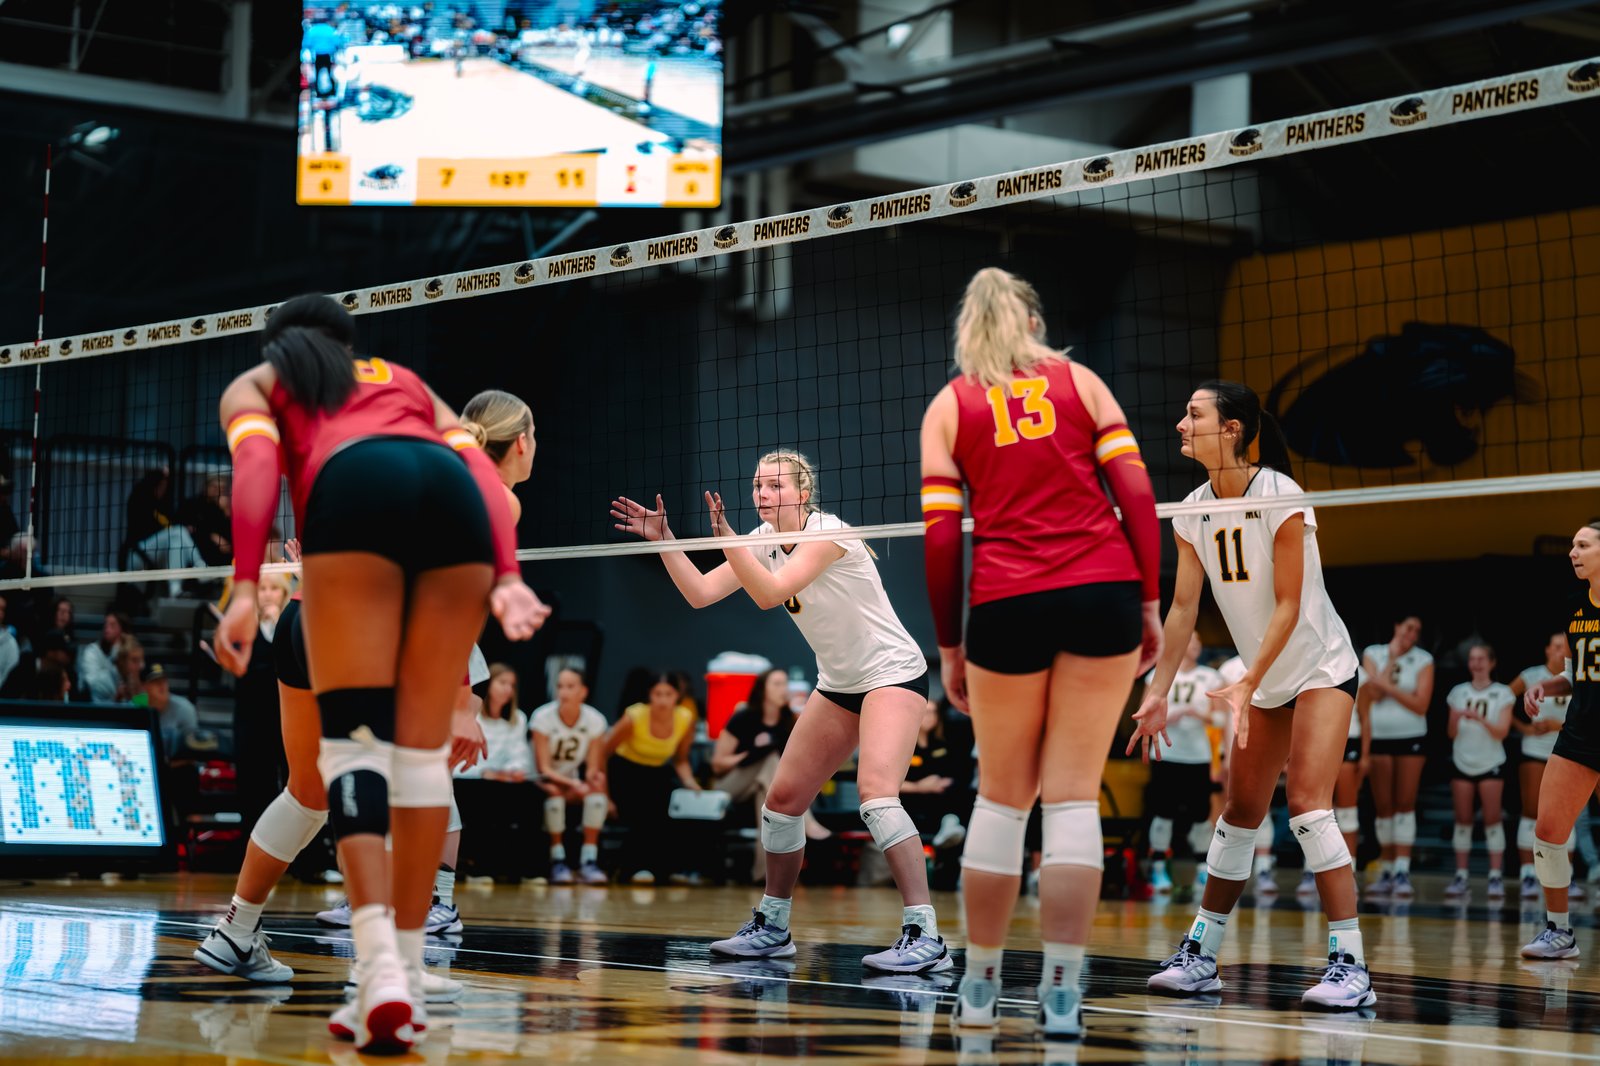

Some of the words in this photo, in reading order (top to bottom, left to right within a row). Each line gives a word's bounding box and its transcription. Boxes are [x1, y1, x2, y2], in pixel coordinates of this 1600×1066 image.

[440, 167, 456, 189] 7
[556, 168, 585, 188] 11
[82, 335, 114, 351] PANTHERS
[147, 325, 181, 341] PANTHERS
[217, 313, 252, 332] PANTHERS
[370, 288, 412, 307] PANTHERS
[456, 271, 500, 293] PANTHERS
[549, 255, 596, 278] PANTHERS
[647, 236, 698, 260] PANTHERS
[754, 215, 810, 241] PANTHERS
[870, 194, 931, 221] PANTHERS
[997, 169, 1062, 198] PANTHERS
[1135, 143, 1206, 173] PANTHERS
[1286, 112, 1365, 146] PANTHERS
[1452, 79, 1539, 115] PANTHERS
[986, 376, 1057, 447] 13
[1213, 527, 1249, 582] 11
[1575, 637, 1600, 682] 13
[1173, 684, 1195, 703] 17
[551, 737, 579, 761] 12
